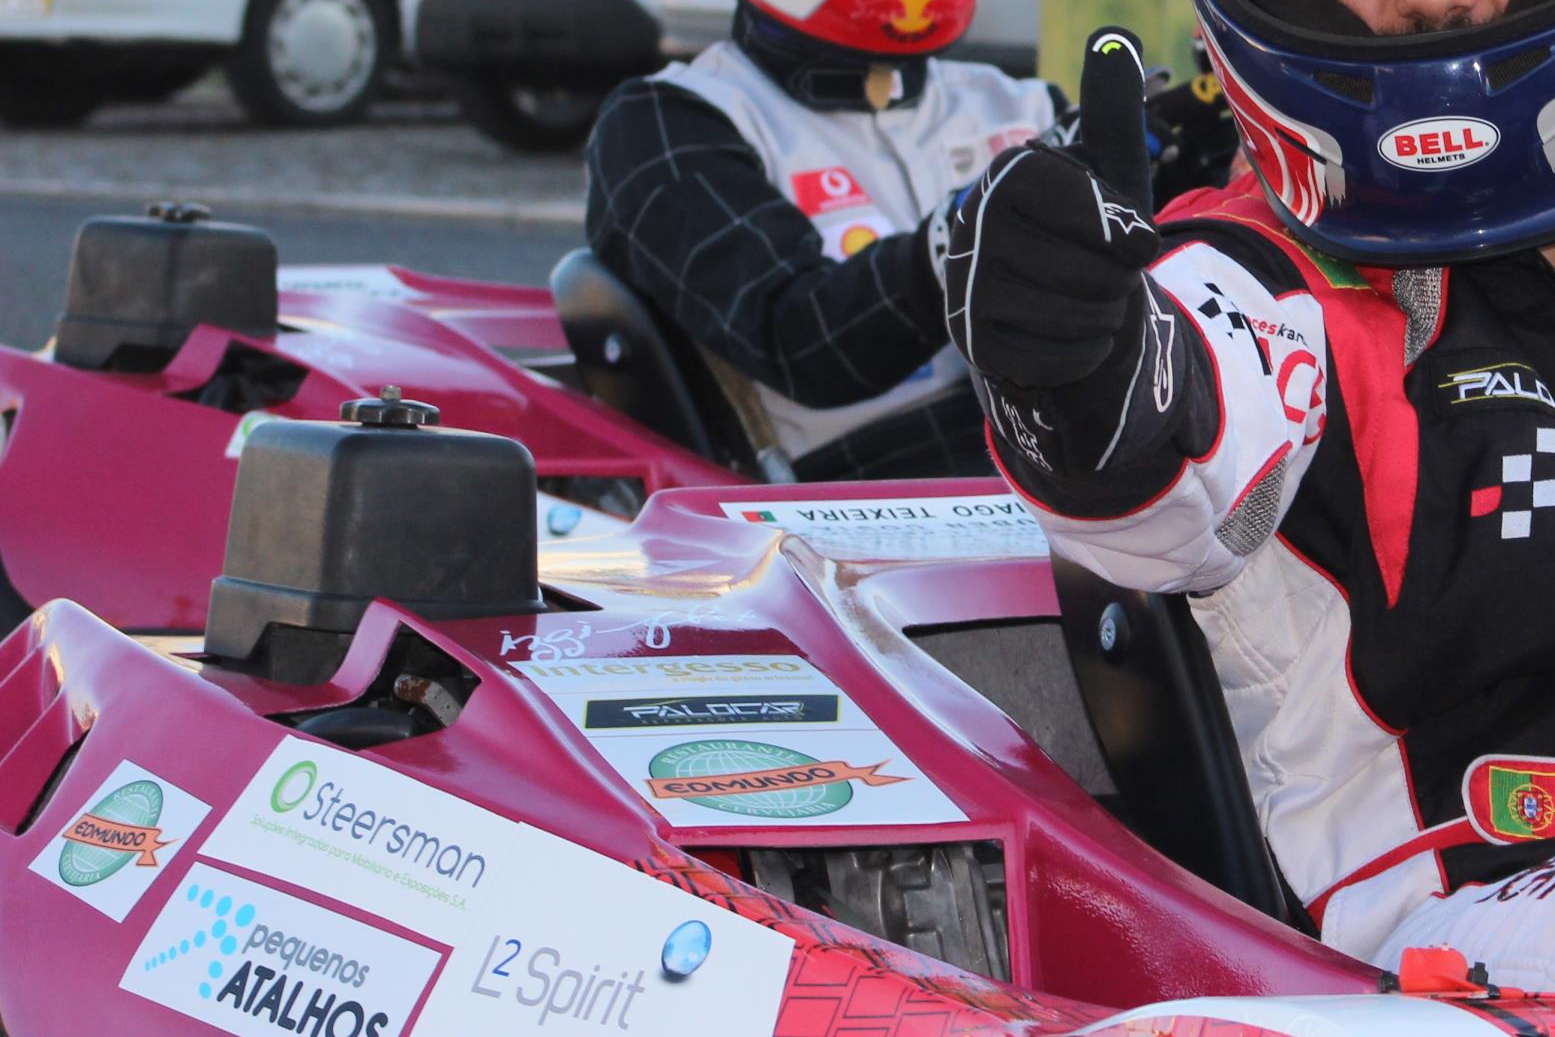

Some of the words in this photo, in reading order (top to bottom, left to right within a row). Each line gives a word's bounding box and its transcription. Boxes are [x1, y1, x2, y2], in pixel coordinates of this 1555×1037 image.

[1394, 128, 1484, 157] BELL
[1416, 153, 1466, 165] HELMETS
[797, 506, 936, 522] TEIXEIRA
[953, 502, 1028, 516] IAGO
[528, 659, 801, 677] Intergesso
[623, 701, 804, 719] PALOCAR
[661, 741, 799, 766] RESTAURANTE
[663, 767, 836, 794] EDMUNDO
[74, 821, 147, 846] EDMUNDO
[303, 781, 487, 889] Steersman
[241, 923, 370, 988] pequenos
[216, 959, 389, 1037] ATALHOS
[516, 947, 645, 1031] Spirit
